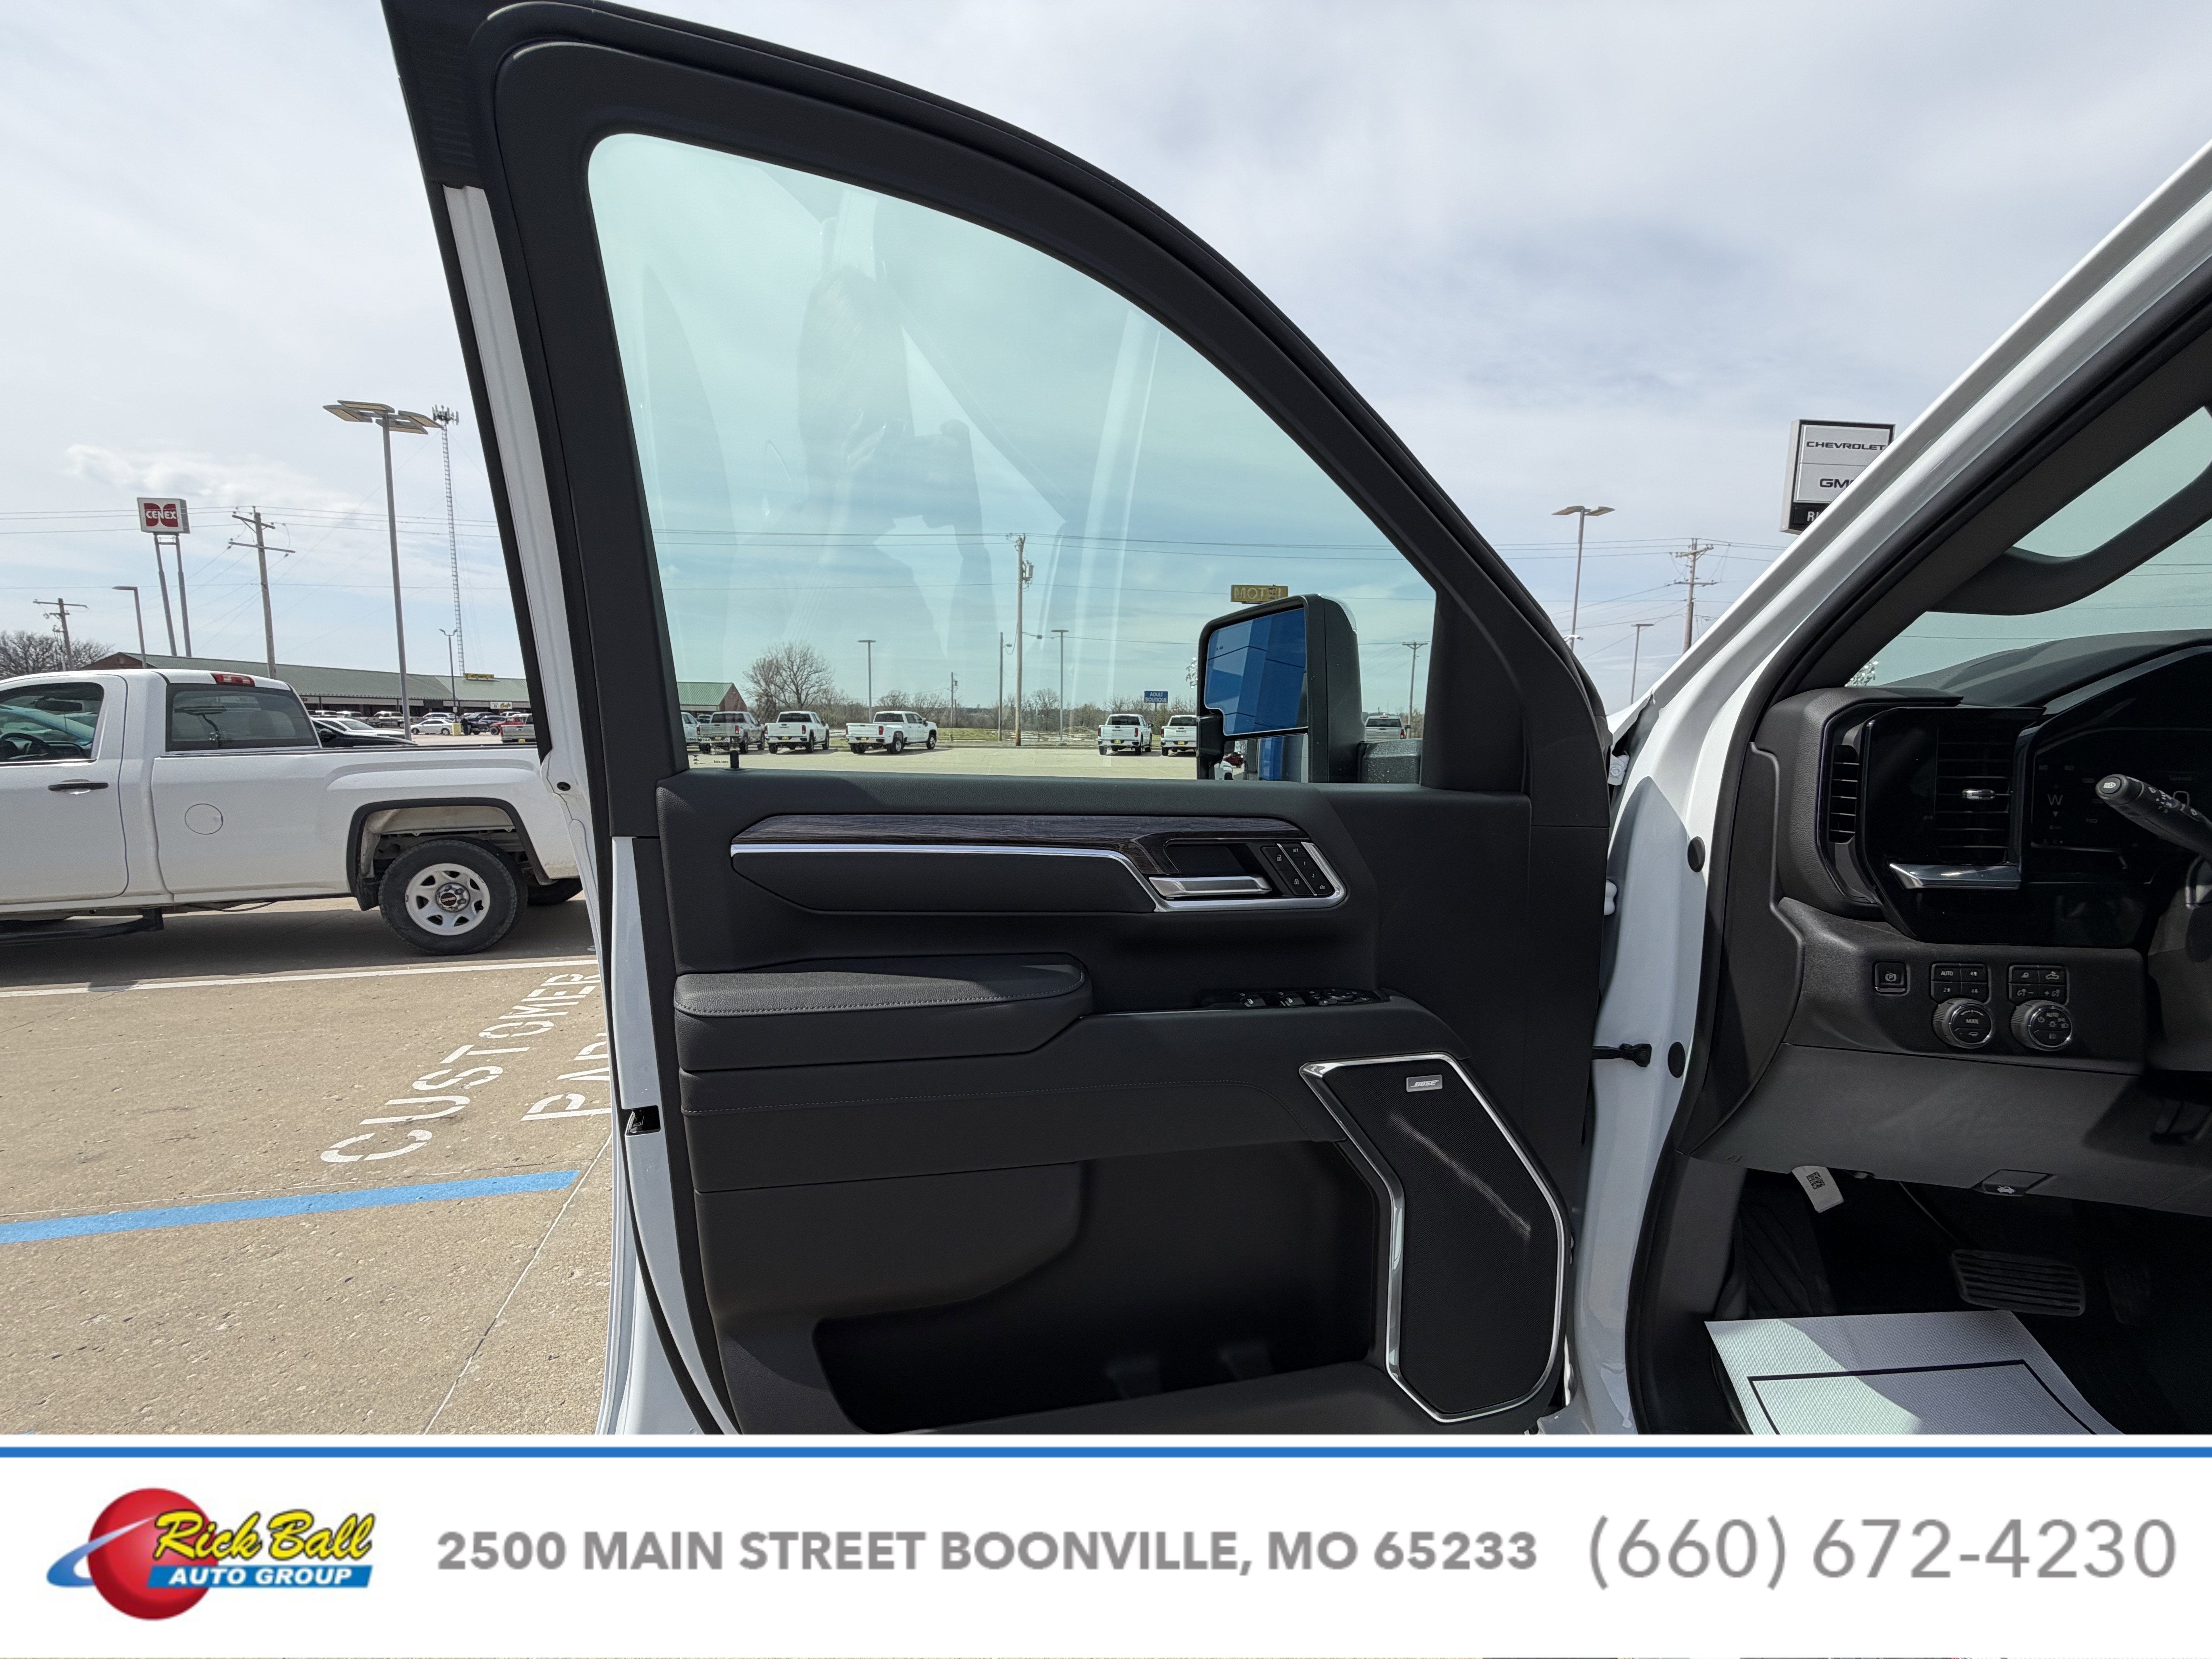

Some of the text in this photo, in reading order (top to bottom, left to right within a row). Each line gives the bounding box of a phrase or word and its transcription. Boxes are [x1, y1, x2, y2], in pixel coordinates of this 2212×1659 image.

[1806, 441, 1886, 450] CHEVROLET
[1820, 478, 1854, 488] GM
[146, 510, 177, 519] CENEX
[1807, 511, 1819, 521] RI
[320, 974, 601, 1163] CUSTOMER
